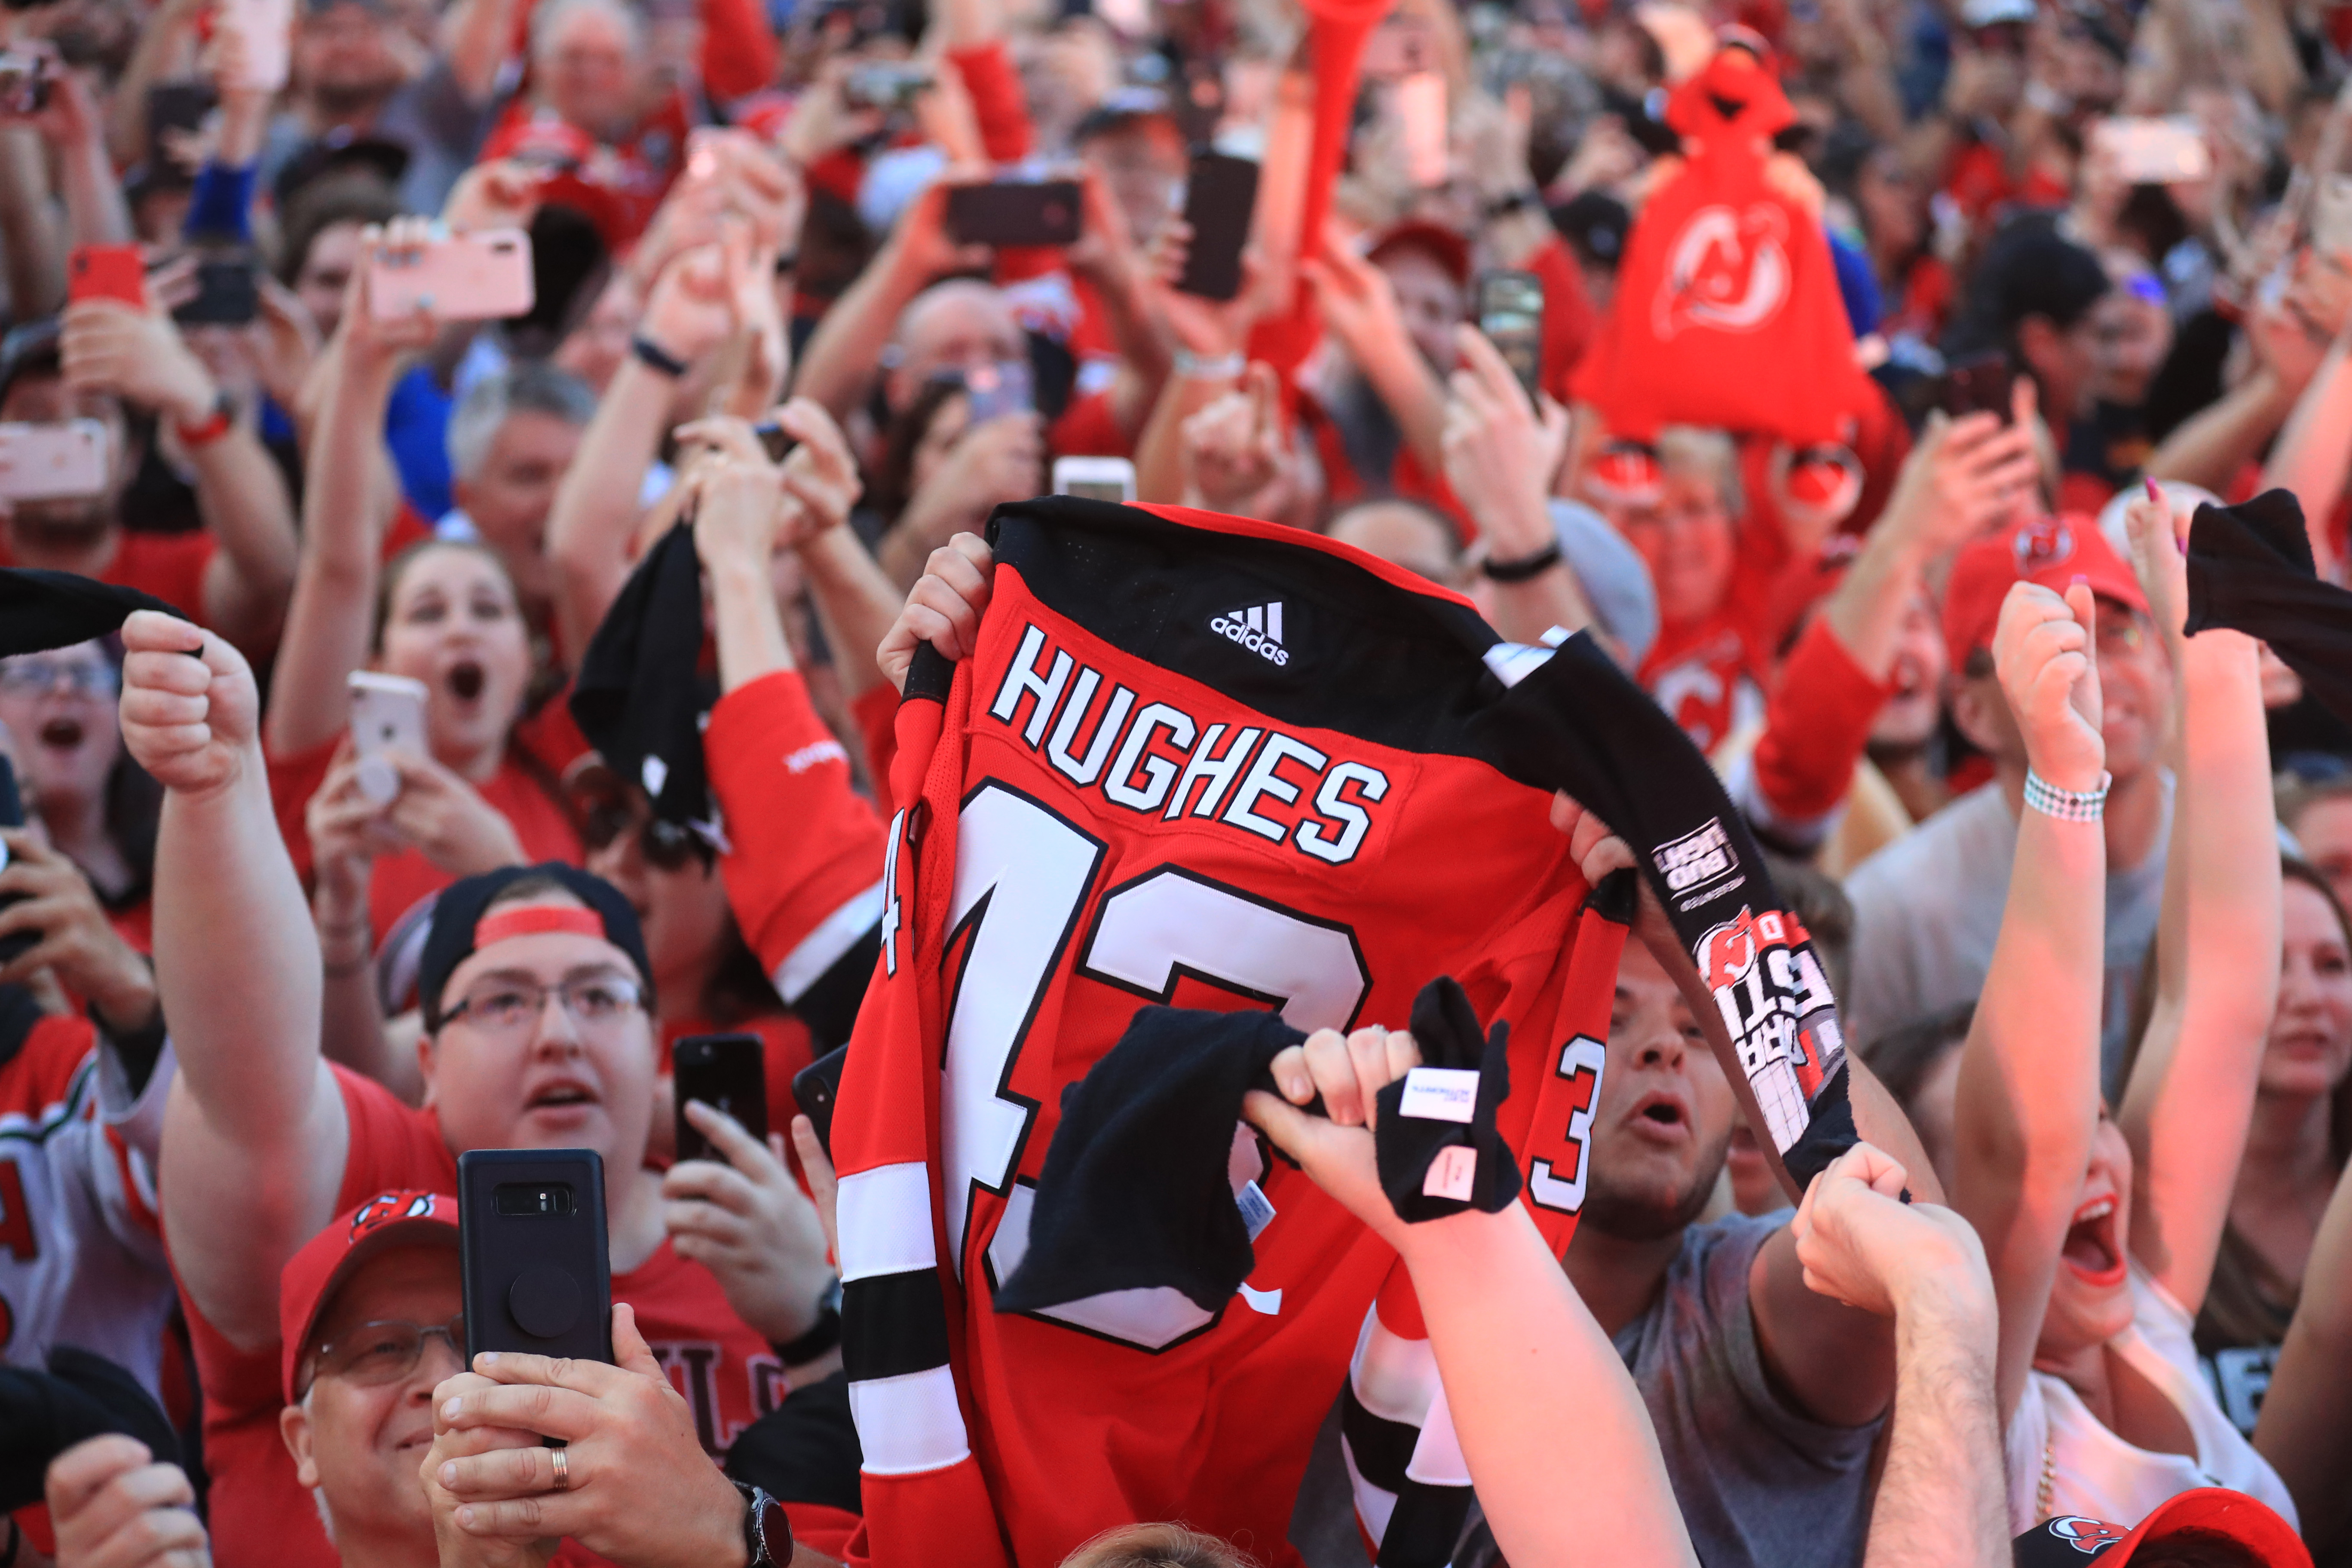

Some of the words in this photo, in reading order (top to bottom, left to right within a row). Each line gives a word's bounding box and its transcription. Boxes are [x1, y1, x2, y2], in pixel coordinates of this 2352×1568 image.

[1210, 617, 1289, 666] adidas
[989, 622, 1390, 865] HUGHES
[1653, 824, 1728, 874] LIGHT
[1666, 847, 1728, 891] BUD
[1527, 1032, 1605, 1216] 3
